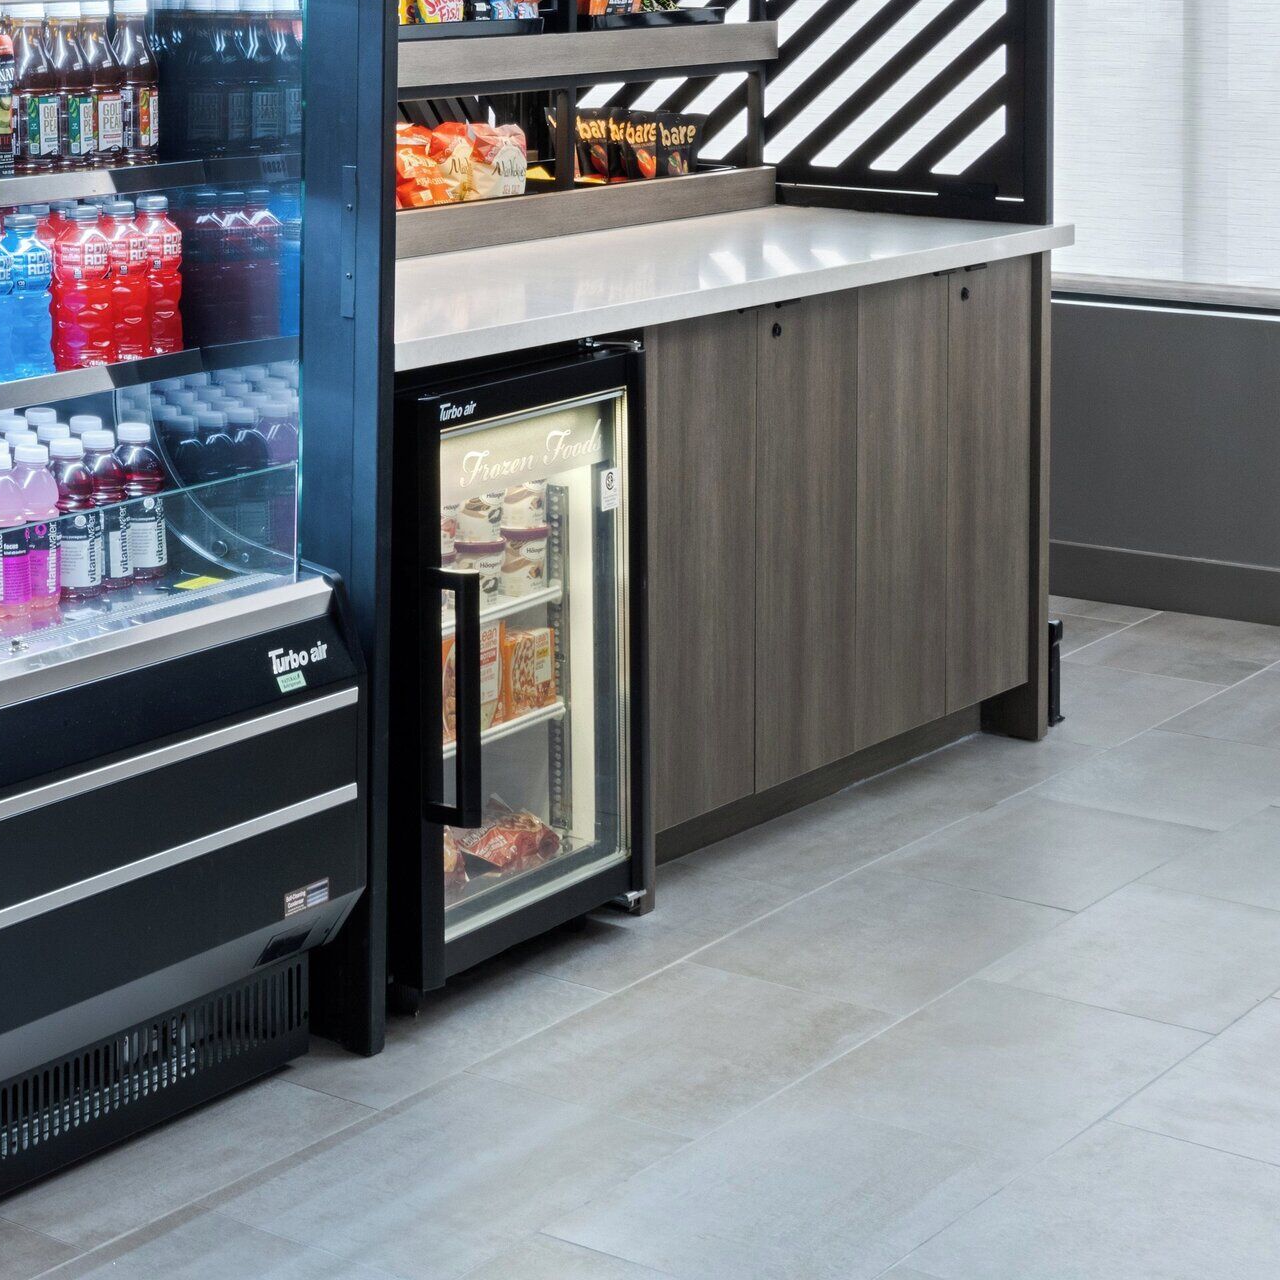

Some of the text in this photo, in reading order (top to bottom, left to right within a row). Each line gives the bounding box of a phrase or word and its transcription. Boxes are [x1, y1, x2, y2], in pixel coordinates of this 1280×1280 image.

[437, 3, 460, 22] Fish
[625, 120, 657, 144] bare
[659, 121, 696, 147] bare
[84, 254, 108, 265] ADE
[163, 244, 181, 255] ADE
[28, 263, 49, 275] ADE
[440, 400, 477, 421] Turbo air
[459, 418, 602, 488] Frozen Foods
[87, 514, 96, 583] vitaminwater
[119, 506, 128, 573] vitaminwater
[46, 522, 57, 594] vitaminwater
[268, 640, 328, 675] Turbo air
